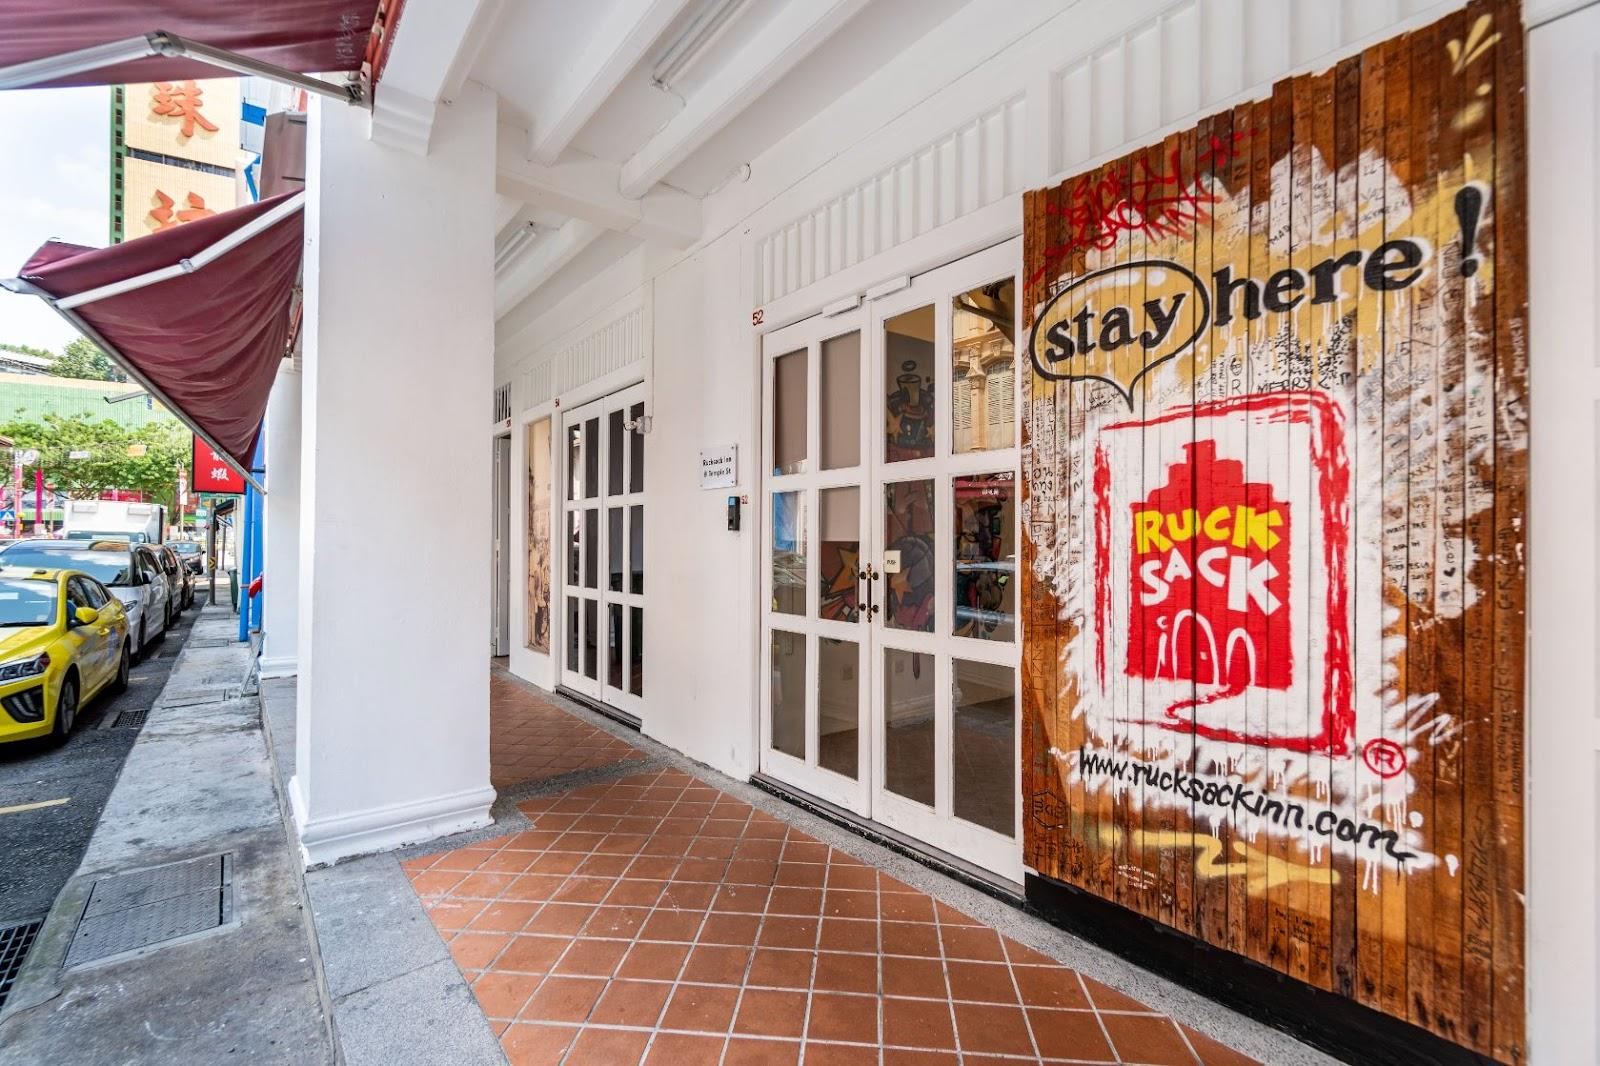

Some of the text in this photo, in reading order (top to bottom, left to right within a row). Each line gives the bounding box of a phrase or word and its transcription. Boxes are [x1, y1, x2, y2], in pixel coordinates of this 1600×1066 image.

[752, 309, 764, 326] 52
[1044, 291, 1189, 366] stay
[702, 457, 723, 467] Rucksack
[708, 470, 725, 478] Temple
[1135, 505, 1283, 554] RUCK
[1139, 546, 1282, 616] SACK
[1153, 608, 1256, 687] inn
[1079, 746, 1420, 864] www.rucksackinn.com
